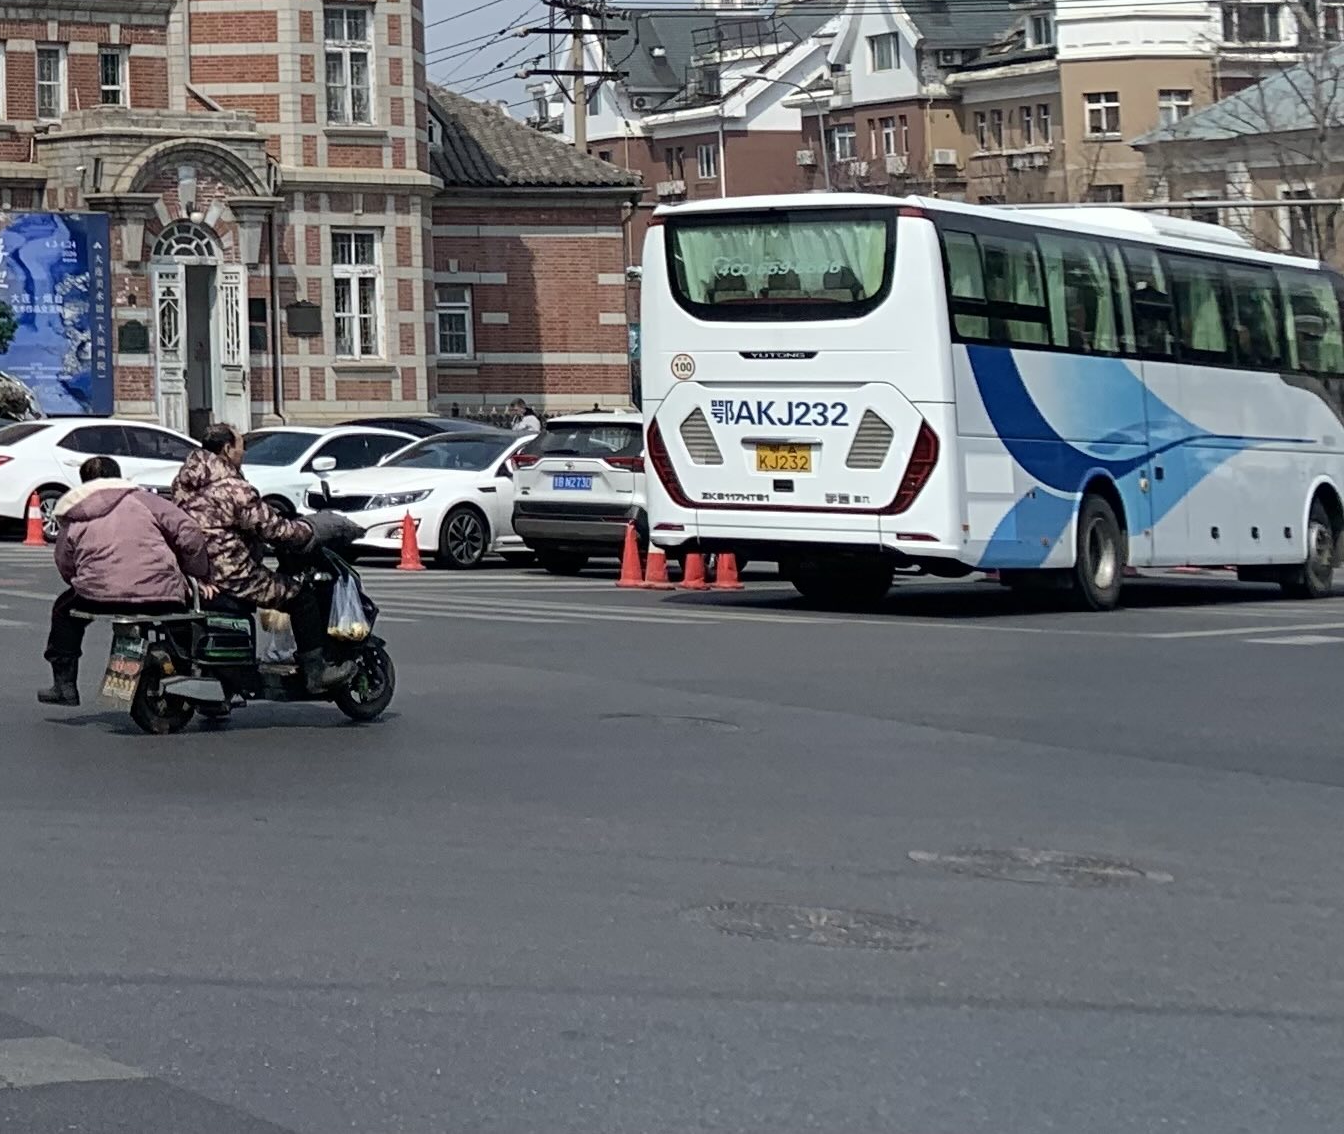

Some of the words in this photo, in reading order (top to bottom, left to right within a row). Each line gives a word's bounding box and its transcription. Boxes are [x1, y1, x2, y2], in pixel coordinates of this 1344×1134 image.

[674, 362, 692, 372] 100
[711, 400, 849, 426] 鄂AKJ232
[759, 455, 809, 470] KJ232
